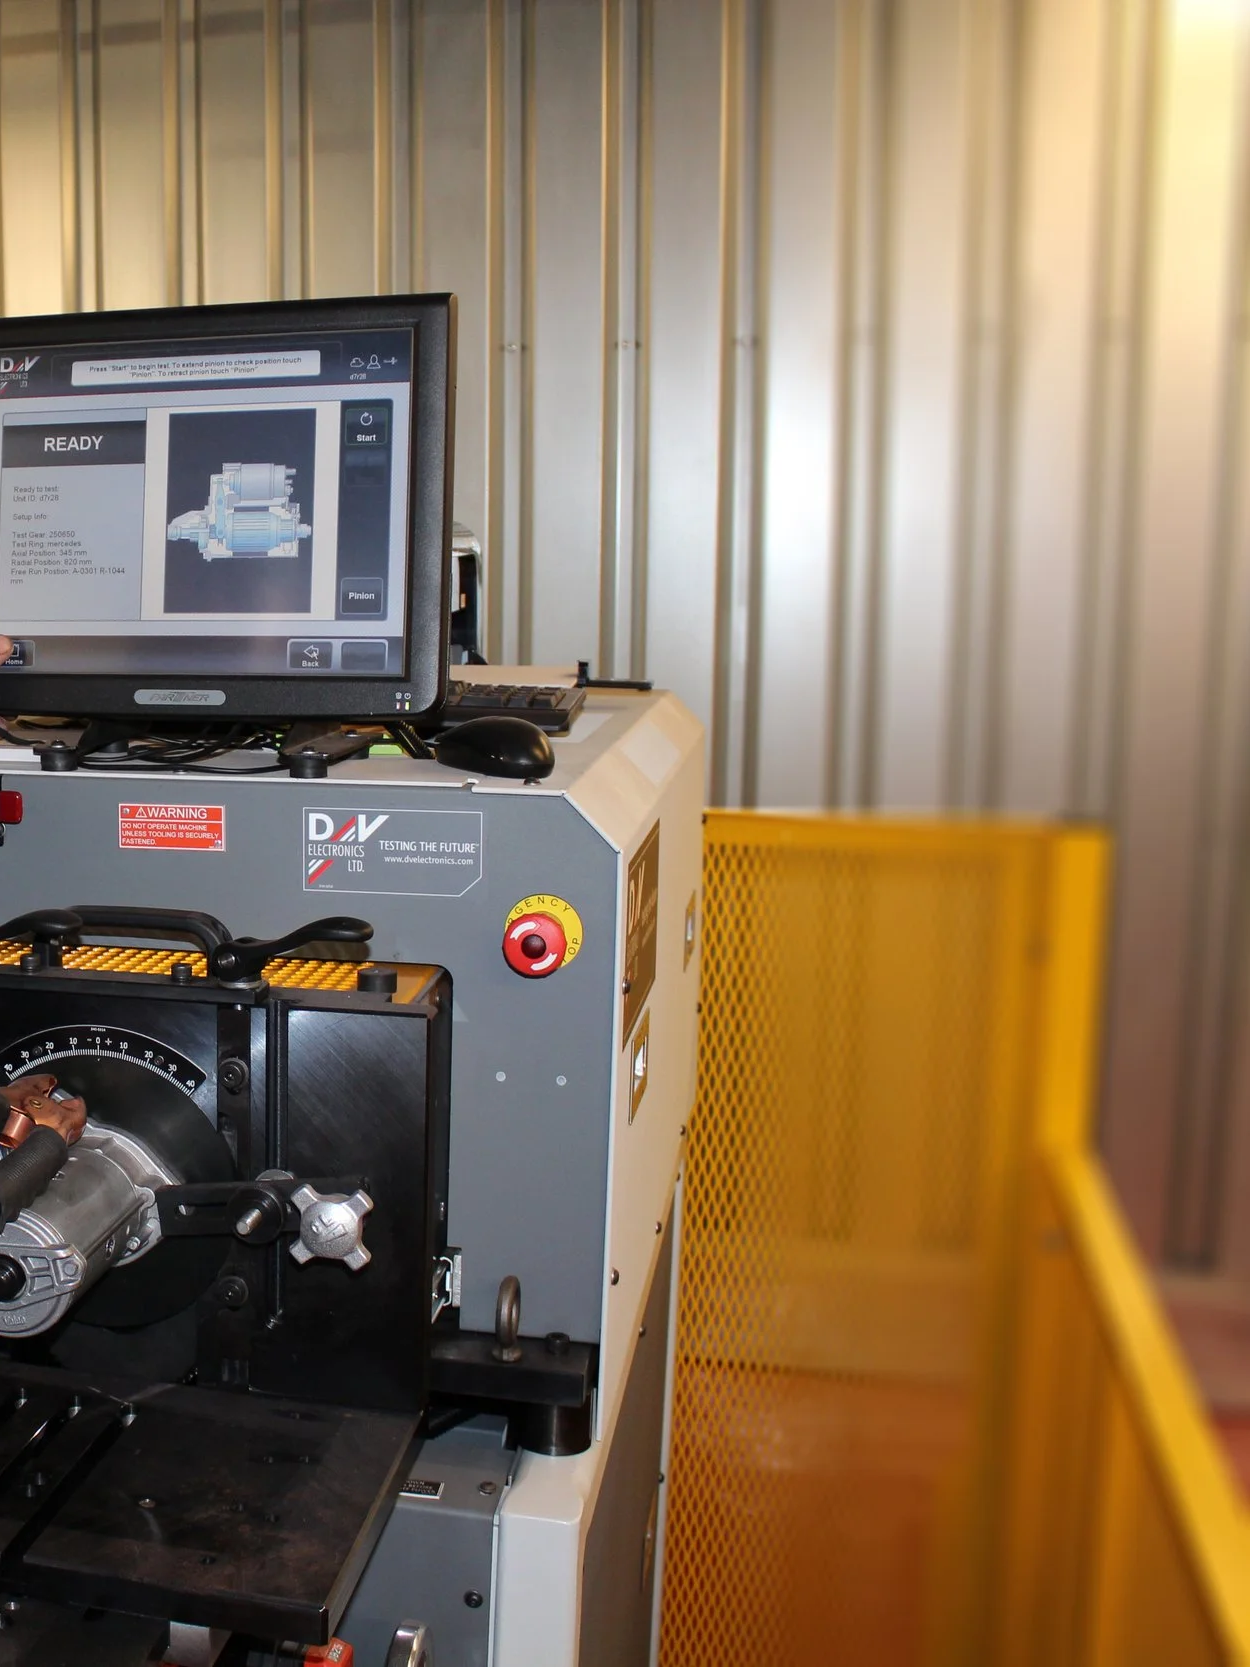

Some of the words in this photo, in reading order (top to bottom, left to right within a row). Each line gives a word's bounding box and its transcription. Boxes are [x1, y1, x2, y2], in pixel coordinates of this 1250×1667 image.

[139, 363, 157, 371] begin
[182, 360, 204, 368] extend
[204, 360, 225, 368] pinion
[190, 368, 210, 376] pinion
[44, 435, 104, 452] READY
[13, 486, 35, 494] Ready
[36, 485, 43, 493] to
[13, 513, 32, 521] Setup
[72, 567, 98, 575] A-0301
[348, 591, 375, 600] Pinion
[147, 807, 208, 819] WARNING
[132, 822, 146, 830] NOT
[308, 843, 365, 858] ELECTRONICS
[379, 840, 417, 852] TESTING
[419, 841, 437, 852] THE
[384, 854, 473, 866] www.dvelectronics.com
[348, 860, 365, 873] LTD.
[4, 1063, 13, 1072] 40
[20, 1051, 30, 1059] 30
[45, 1042, 54, 1050] 20
[69, 1037, 78, 1045] 10
[95, 1036, 100, 1044] 0
[119, 1041, 128, 1049] 10
[144, 1050, 153, 1059] 20
[168, 1063, 177, 1072] 30
[186, 1080, 196, 1088] 40
